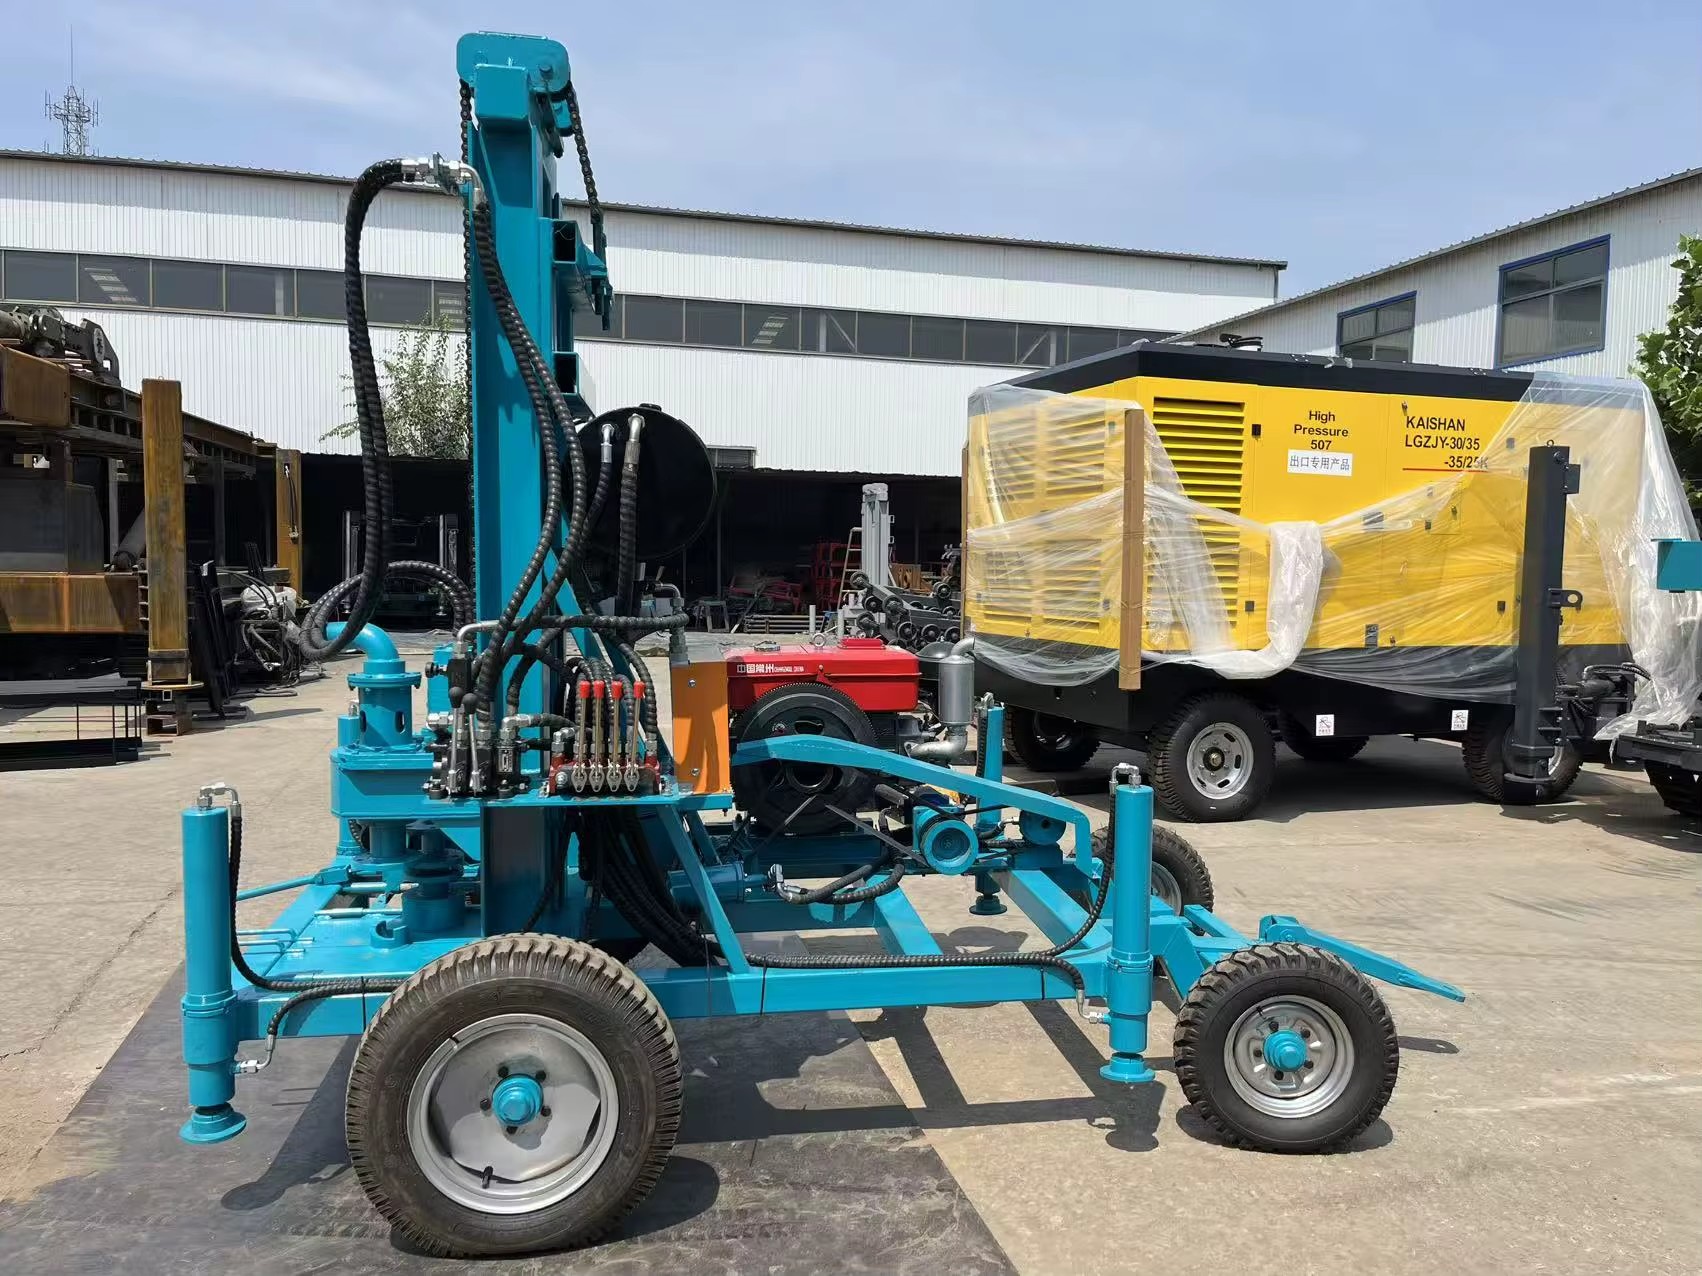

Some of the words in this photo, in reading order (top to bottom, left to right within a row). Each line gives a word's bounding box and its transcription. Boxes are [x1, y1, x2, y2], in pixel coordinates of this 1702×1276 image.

[1308, 410, 1336, 424] High
[1406, 416, 1465, 431] KAISHAN
[1293, 424, 1349, 437] Pressure
[1310, 440, 1332, 450] 507
[1405, 434, 1480, 450] LGZJY-30/35
[1290, 455, 1349, 471] 出口专用产品
